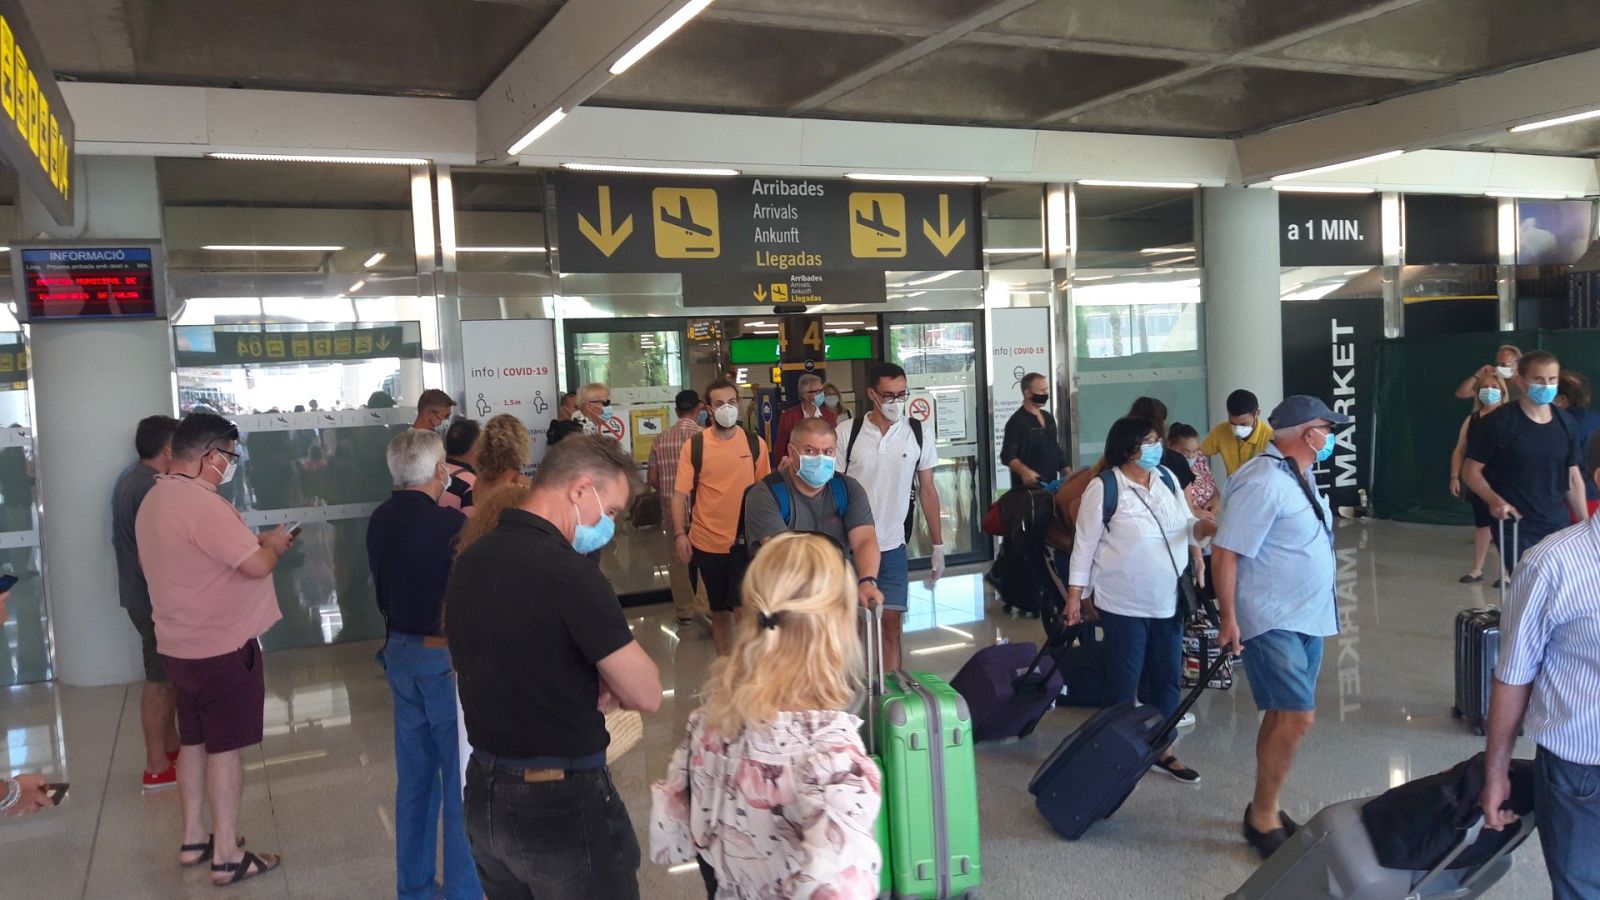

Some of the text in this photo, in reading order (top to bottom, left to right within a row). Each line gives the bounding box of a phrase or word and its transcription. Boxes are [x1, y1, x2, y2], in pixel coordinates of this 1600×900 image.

[752, 178, 825, 196] Arribades
[753, 203, 798, 219] Arrivals
[754, 226, 800, 243] Ankunft
[1287, 219, 1364, 241] a 1 MIN.
[49, 249, 126, 261] INFORMACIÓ
[756, 250, 823, 270] Llegadas
[790, 274, 823, 282] Arribades
[791, 295, 822, 303] Llegadas
[802, 321, 822, 351] 4
[992, 346, 1045, 356] info COVID-19
[471, 366, 549, 378] info COVID-19
[1331, 318, 1358, 488] MARKET
